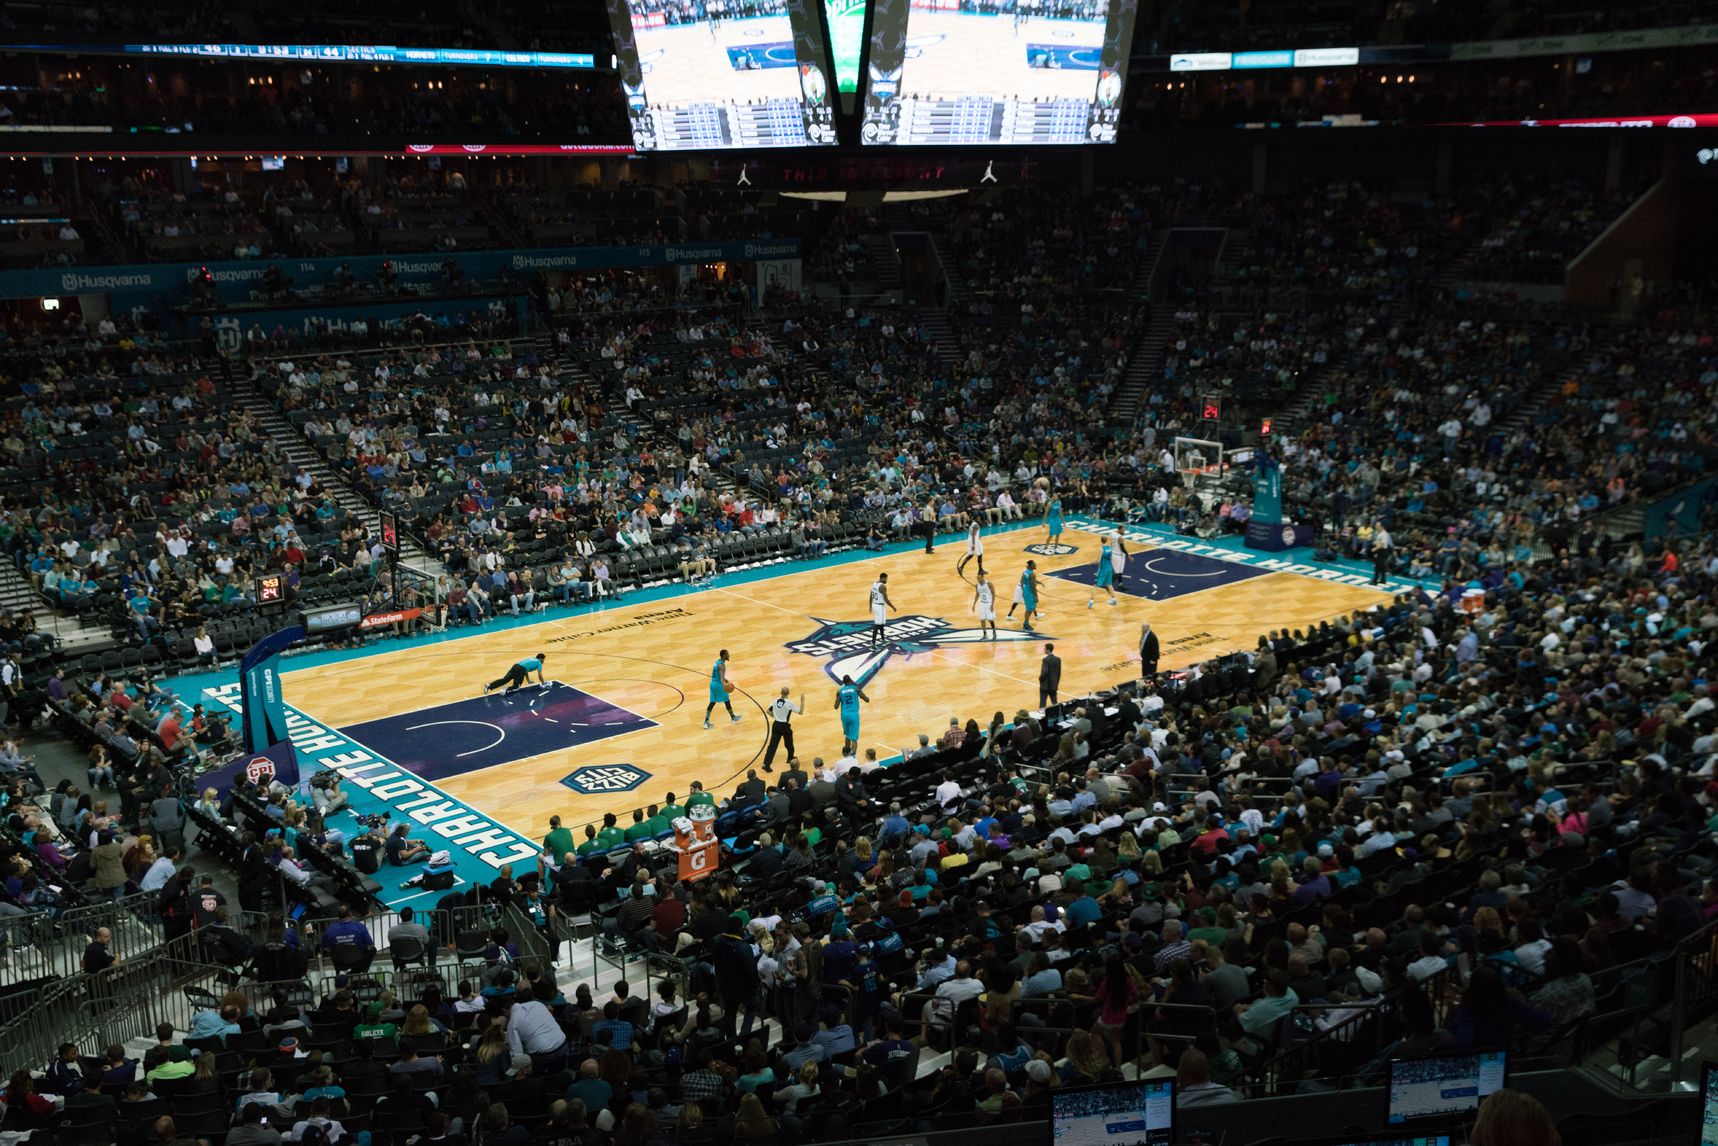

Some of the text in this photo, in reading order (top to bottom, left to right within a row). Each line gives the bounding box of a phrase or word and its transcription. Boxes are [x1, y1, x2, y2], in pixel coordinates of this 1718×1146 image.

[324, 47, 339, 56] 44
[676, 247, 722, 259] Husqvarna
[755, 244, 797, 256] Husqvarna
[301, 262, 315, 272] 114
[525, 255, 577, 267] Husqvarna
[78, 274, 151, 289] Husqvarna
[1204, 405, 1218, 418] 24
[262, 579, 279, 587] 9:53
[263, 588, 277, 599] 24
[633, 608, 684, 620] Arena
[548, 611, 696, 644] Time Warner Cable
[845, 695, 854, 705] 2
[249, 765, 274, 778] CPI
[317, 750, 538, 868] CHARLOTTE
[690, 849, 706, 870] G
